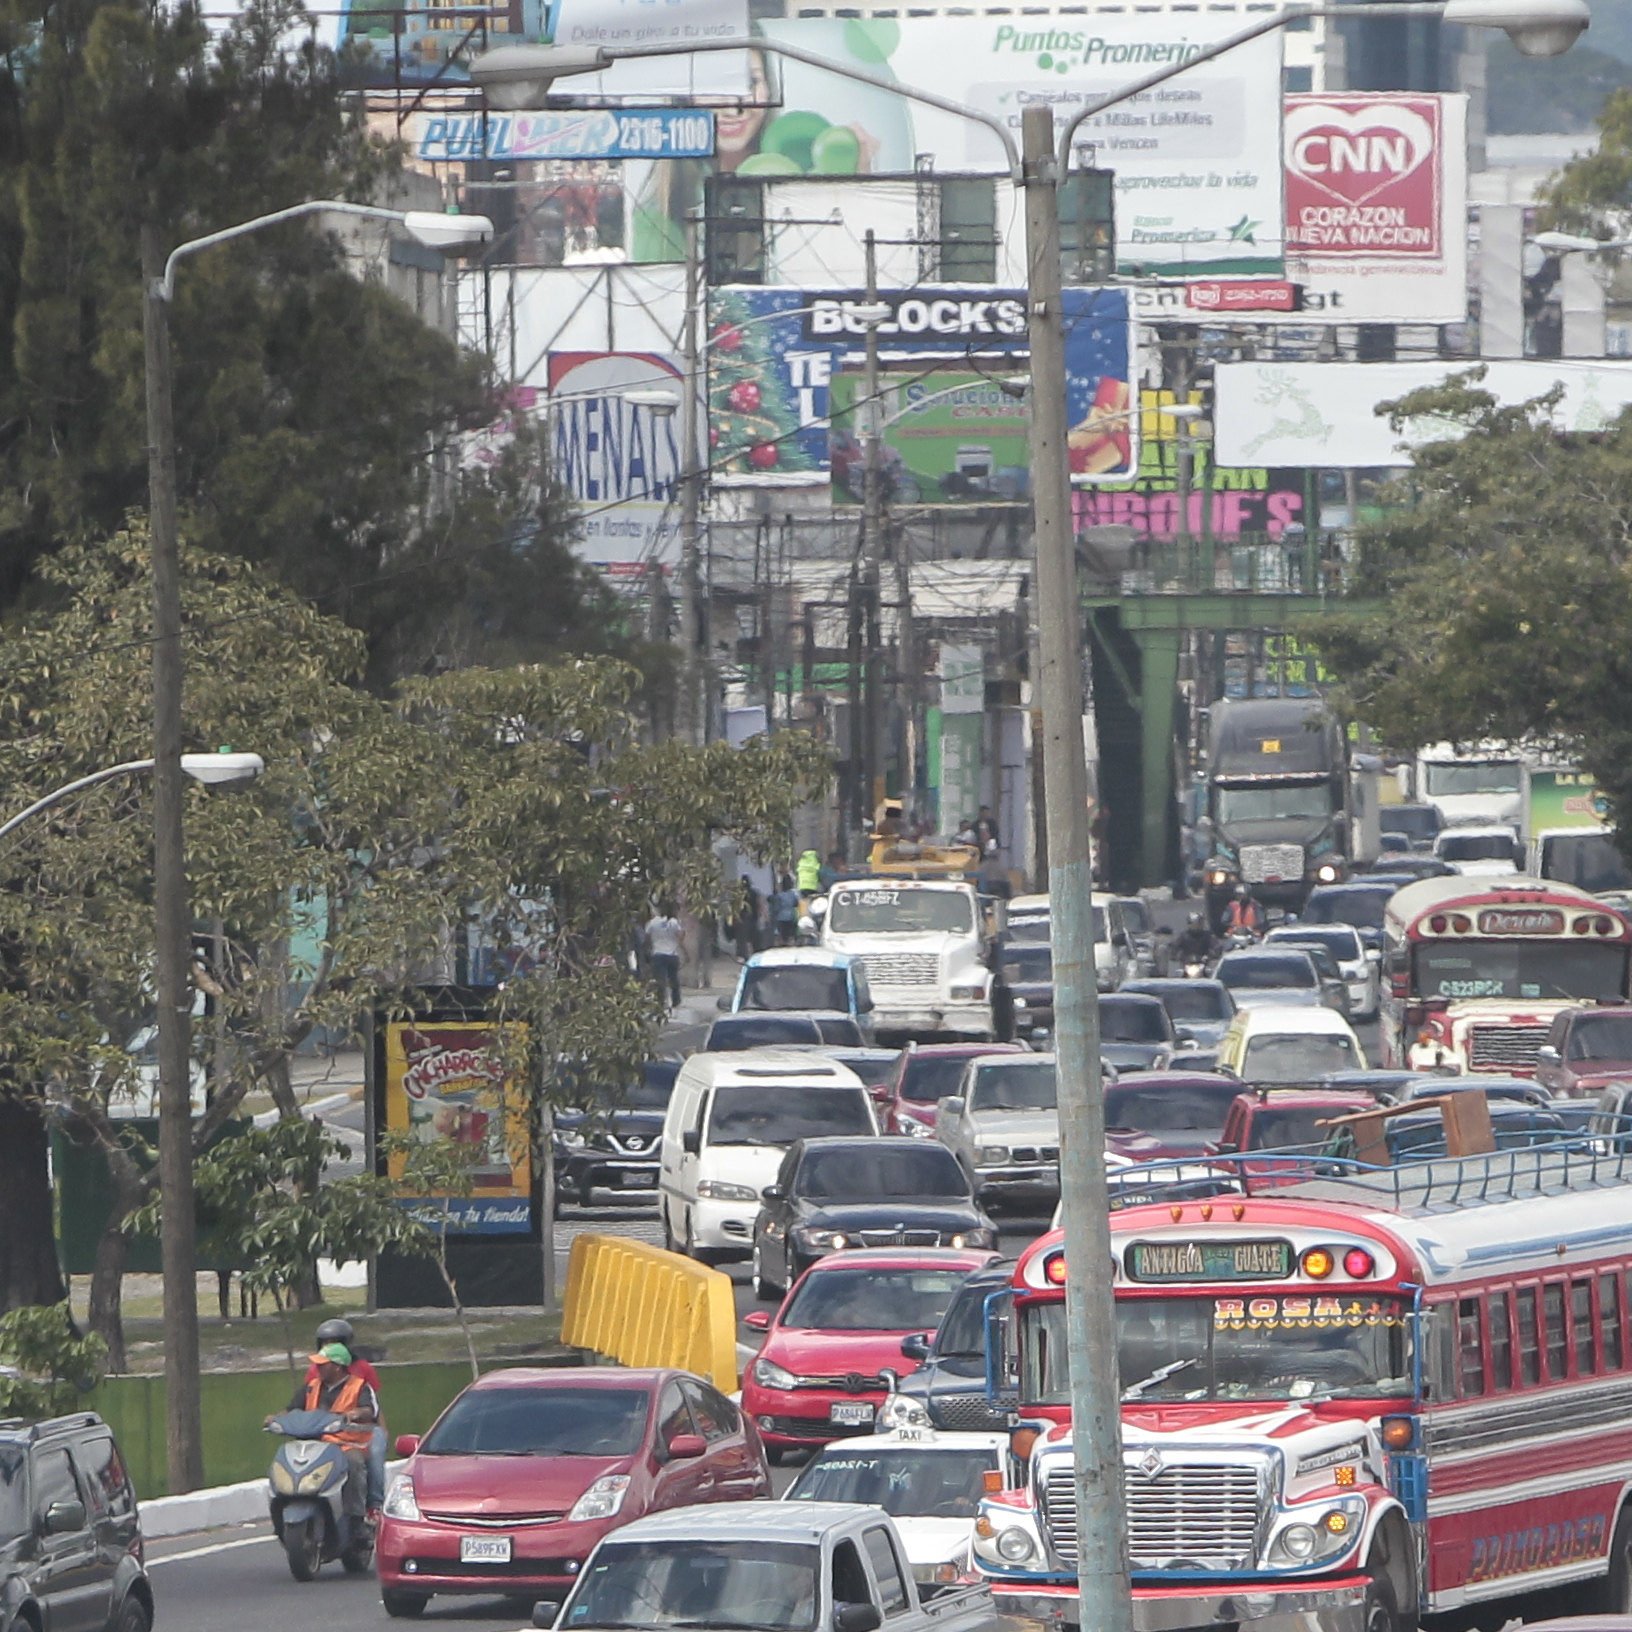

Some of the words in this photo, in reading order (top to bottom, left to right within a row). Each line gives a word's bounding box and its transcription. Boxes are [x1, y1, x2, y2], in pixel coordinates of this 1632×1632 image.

[993, 24, 1086, 52] Puntos
[1294, 134, 1409, 174] CNN
[1299, 206, 1407, 227] CORAZON
[1352, 227, 1432, 245] NACION
[1141, 1244, 1204, 1274] ANTIGUA
[1234, 1244, 1282, 1272] GUATE
[1214, 1297, 1342, 1318] ROSA
[898, 1429, 923, 1440] TAXI
